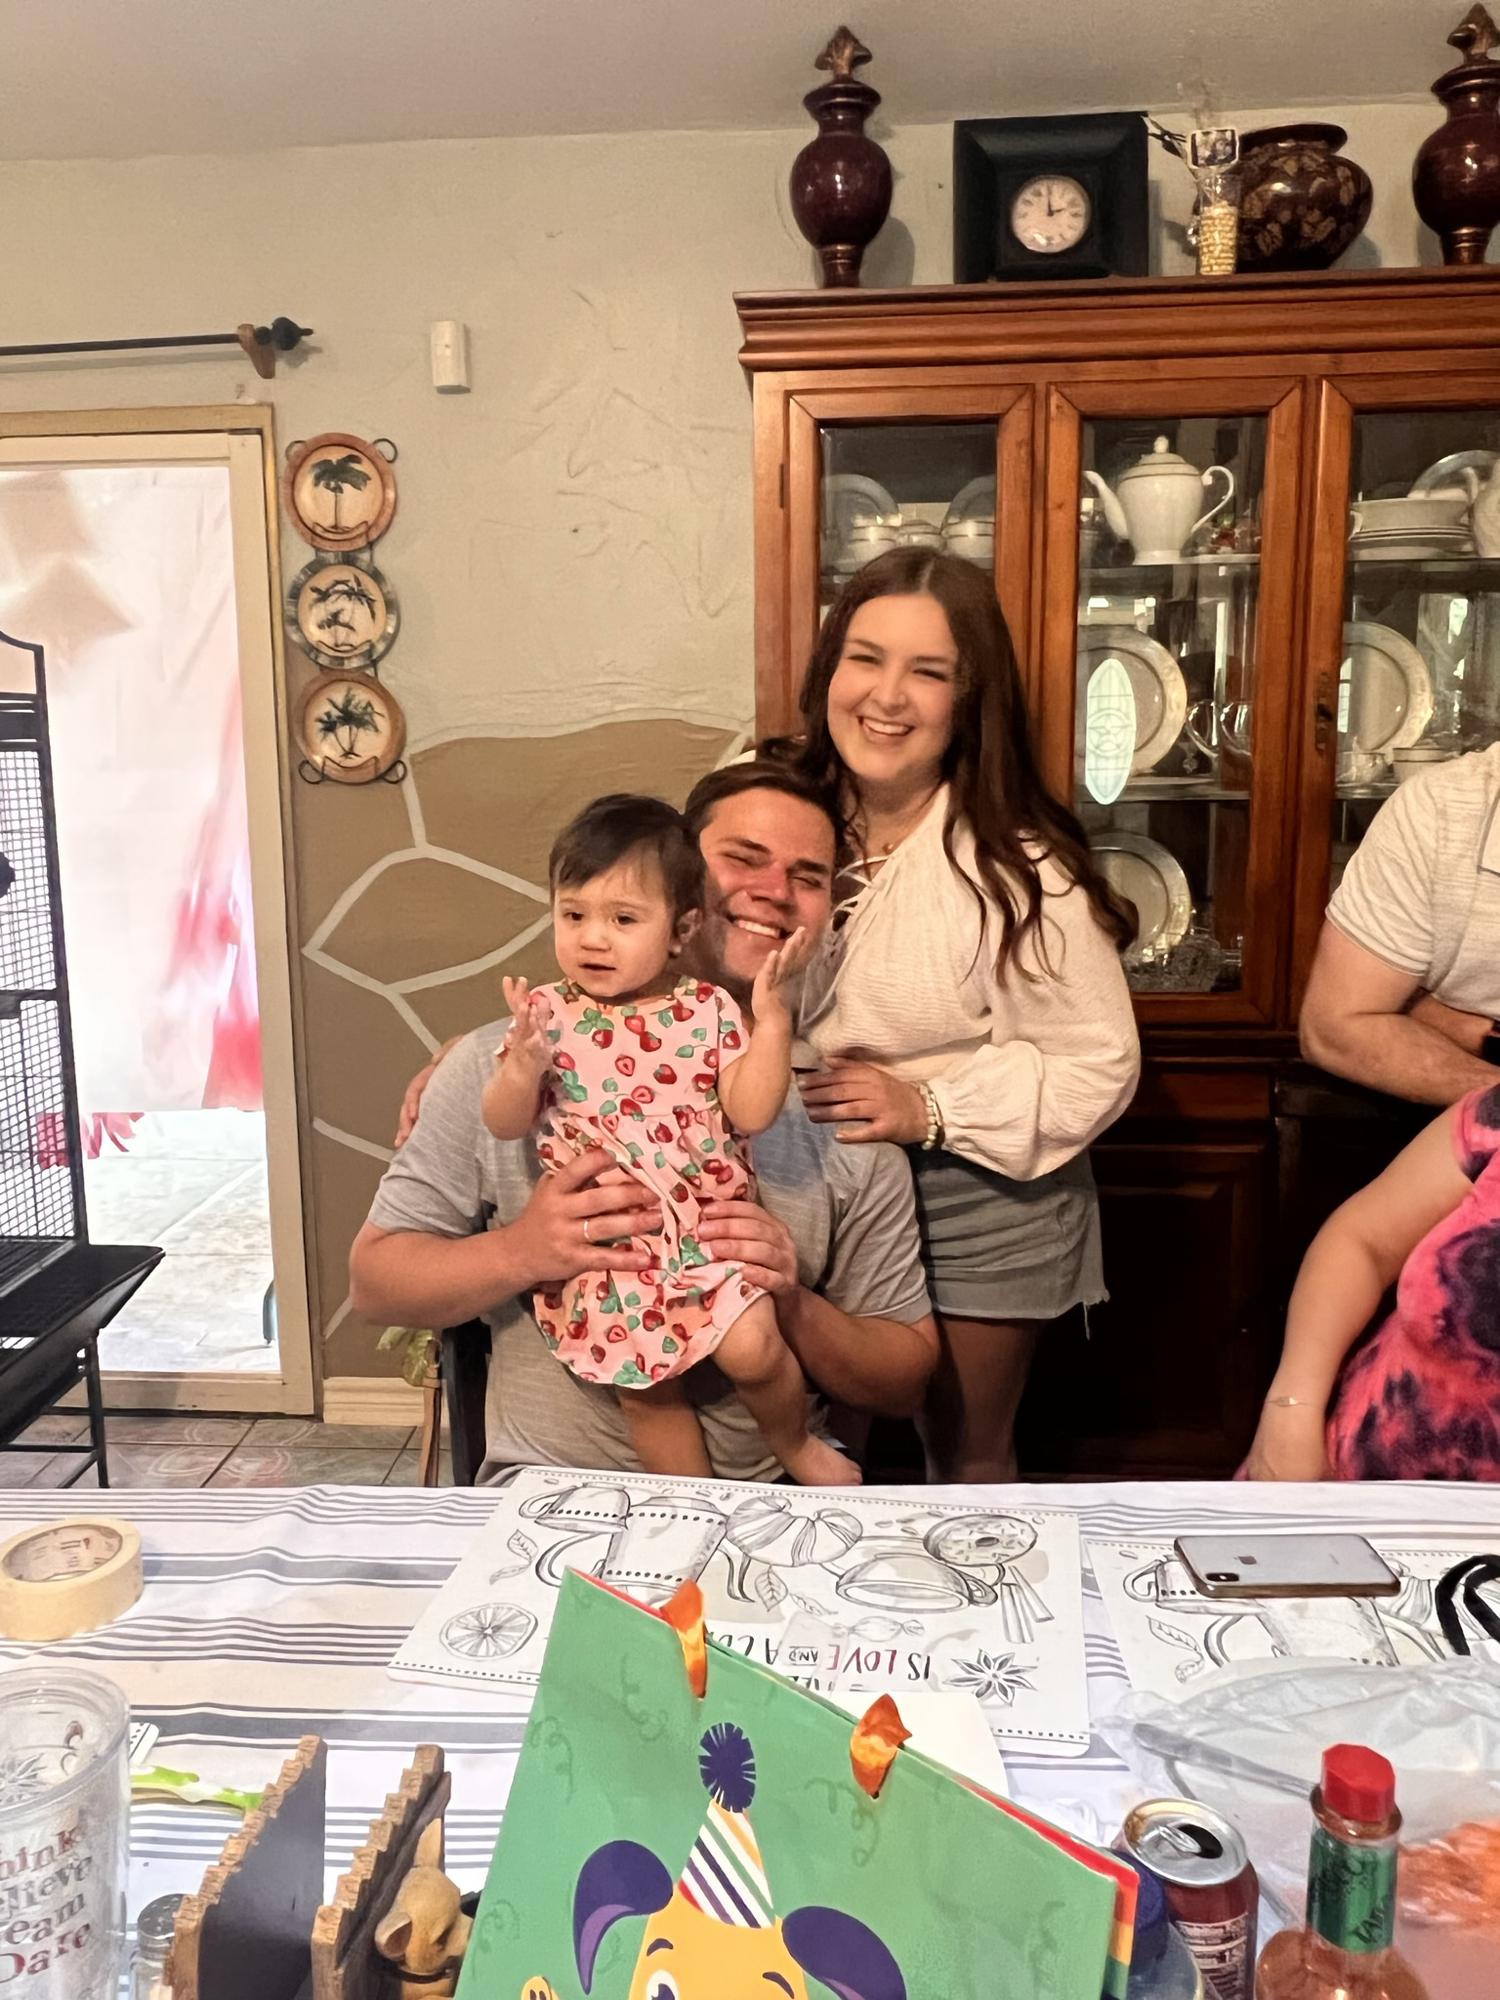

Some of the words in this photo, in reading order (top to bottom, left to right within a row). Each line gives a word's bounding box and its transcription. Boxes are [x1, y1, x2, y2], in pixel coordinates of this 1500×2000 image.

[765, 1637, 778, 1665] A
[788, 1649, 819, 1663] AND
[826, 1644, 897, 1675] LOVE
[908, 1652, 931, 1681] IS
